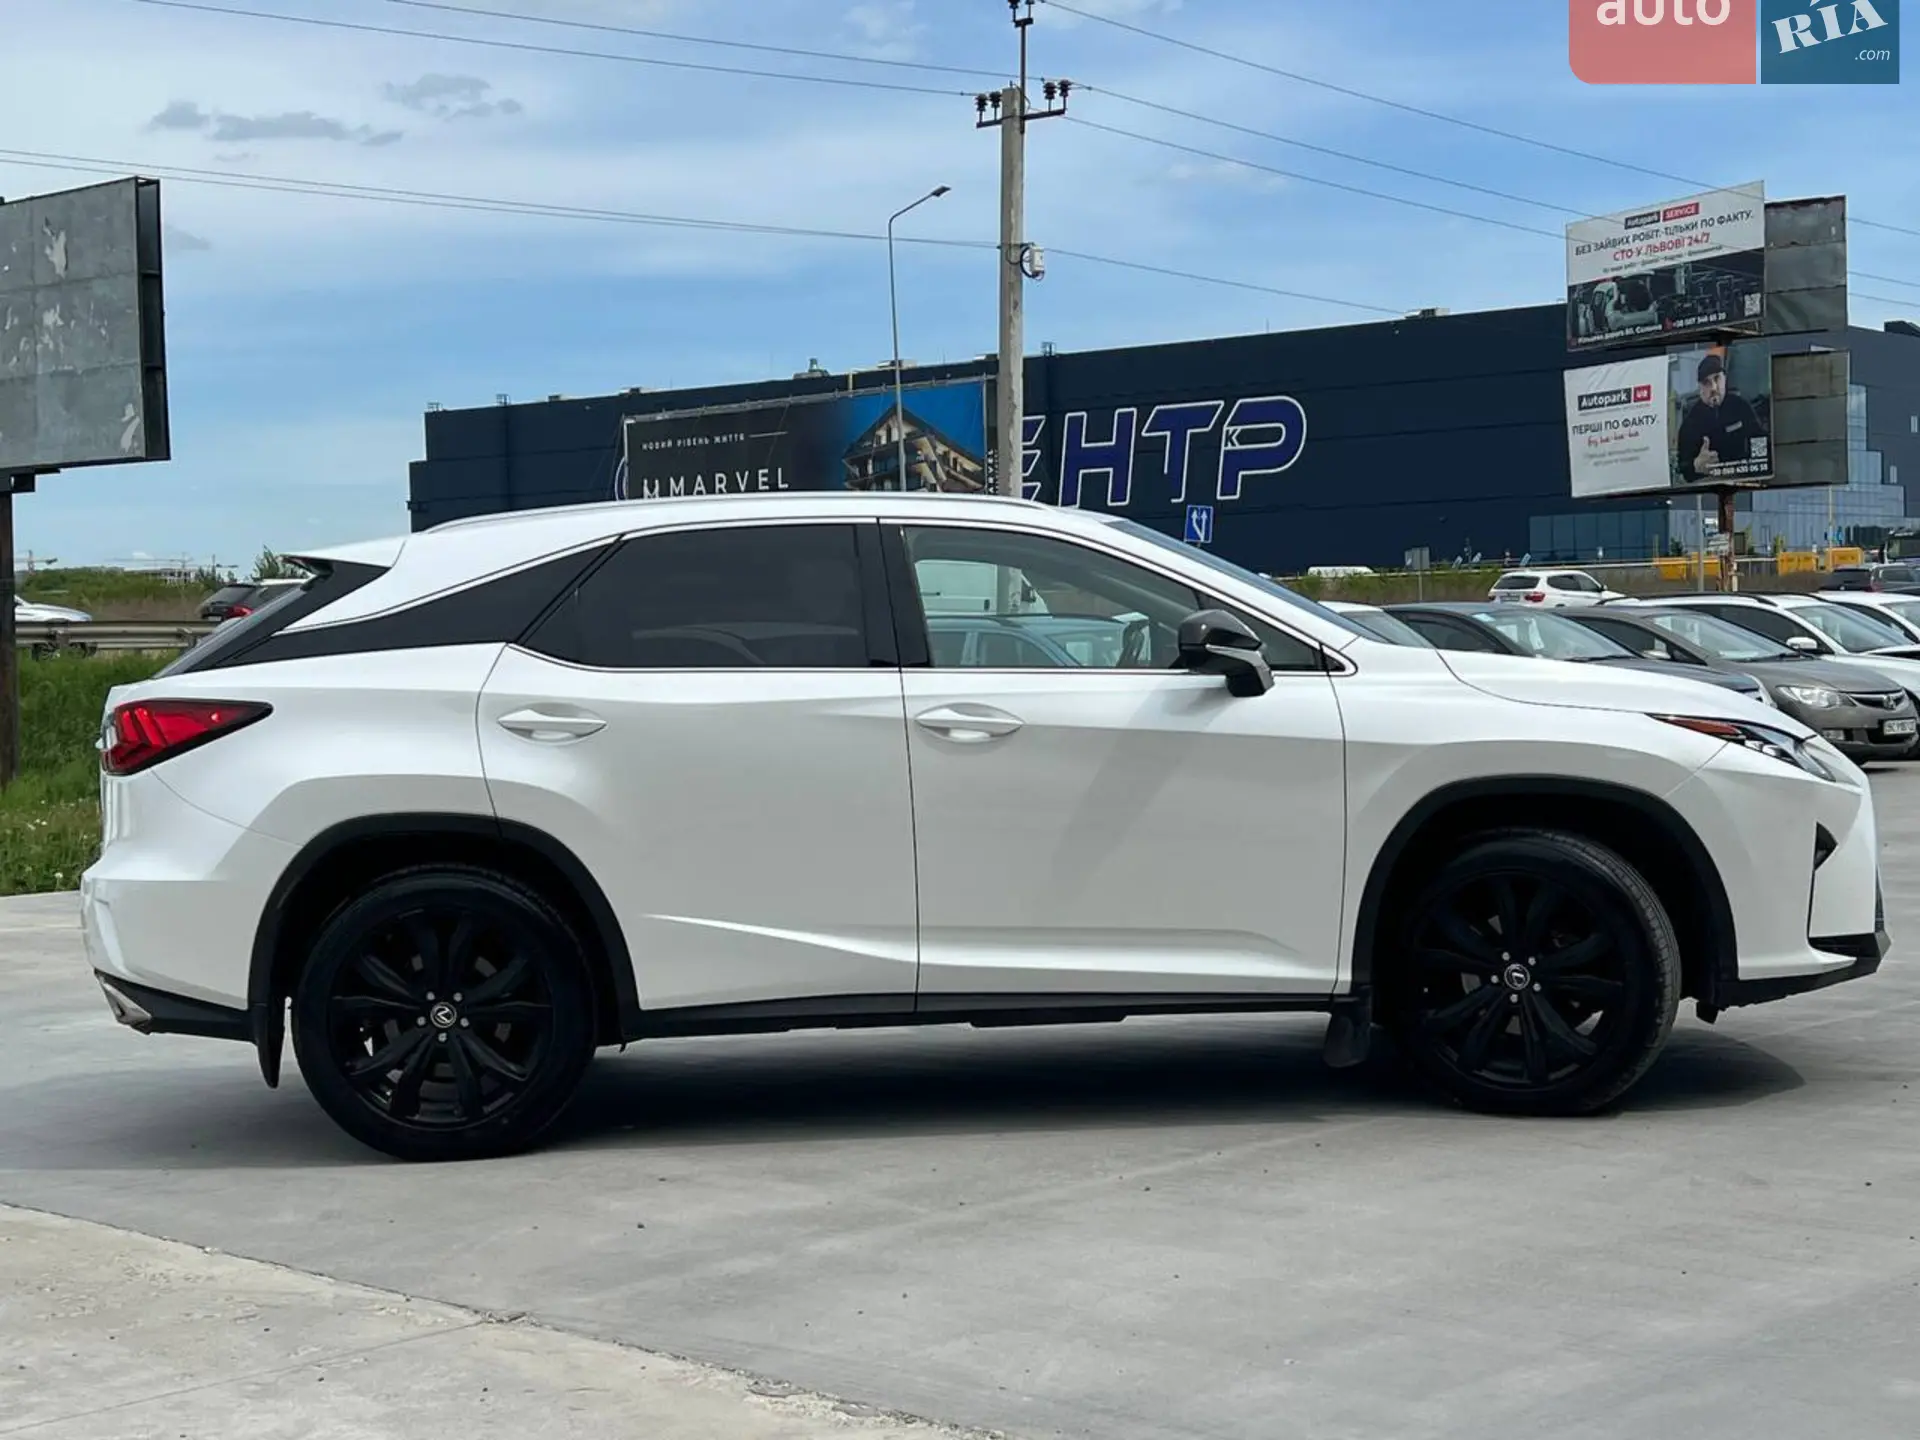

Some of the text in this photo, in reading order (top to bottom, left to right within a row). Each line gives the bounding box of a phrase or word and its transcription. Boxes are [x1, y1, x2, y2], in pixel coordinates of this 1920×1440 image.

[1575, 243, 1591, 256] БЕЗ
[1593, 235, 1630, 253] ЗАЙВИХ
[1700, 217, 1715, 229] ПО
[1613, 249, 1633, 262] СТО
[1645, 236, 1685, 255] ЛЬВОВІ
[1687, 232, 1710, 247] 24/7
[1580, 390, 1628, 408] Autopark
[1572, 421, 1603, 435] ПЕРШІ
[1605, 419, 1620, 430] ПО
[642, 433, 745, 451] НОВИЙ РІВЕНЬ ЖИТТЯ
[669, 467, 789, 498] MARVEL
